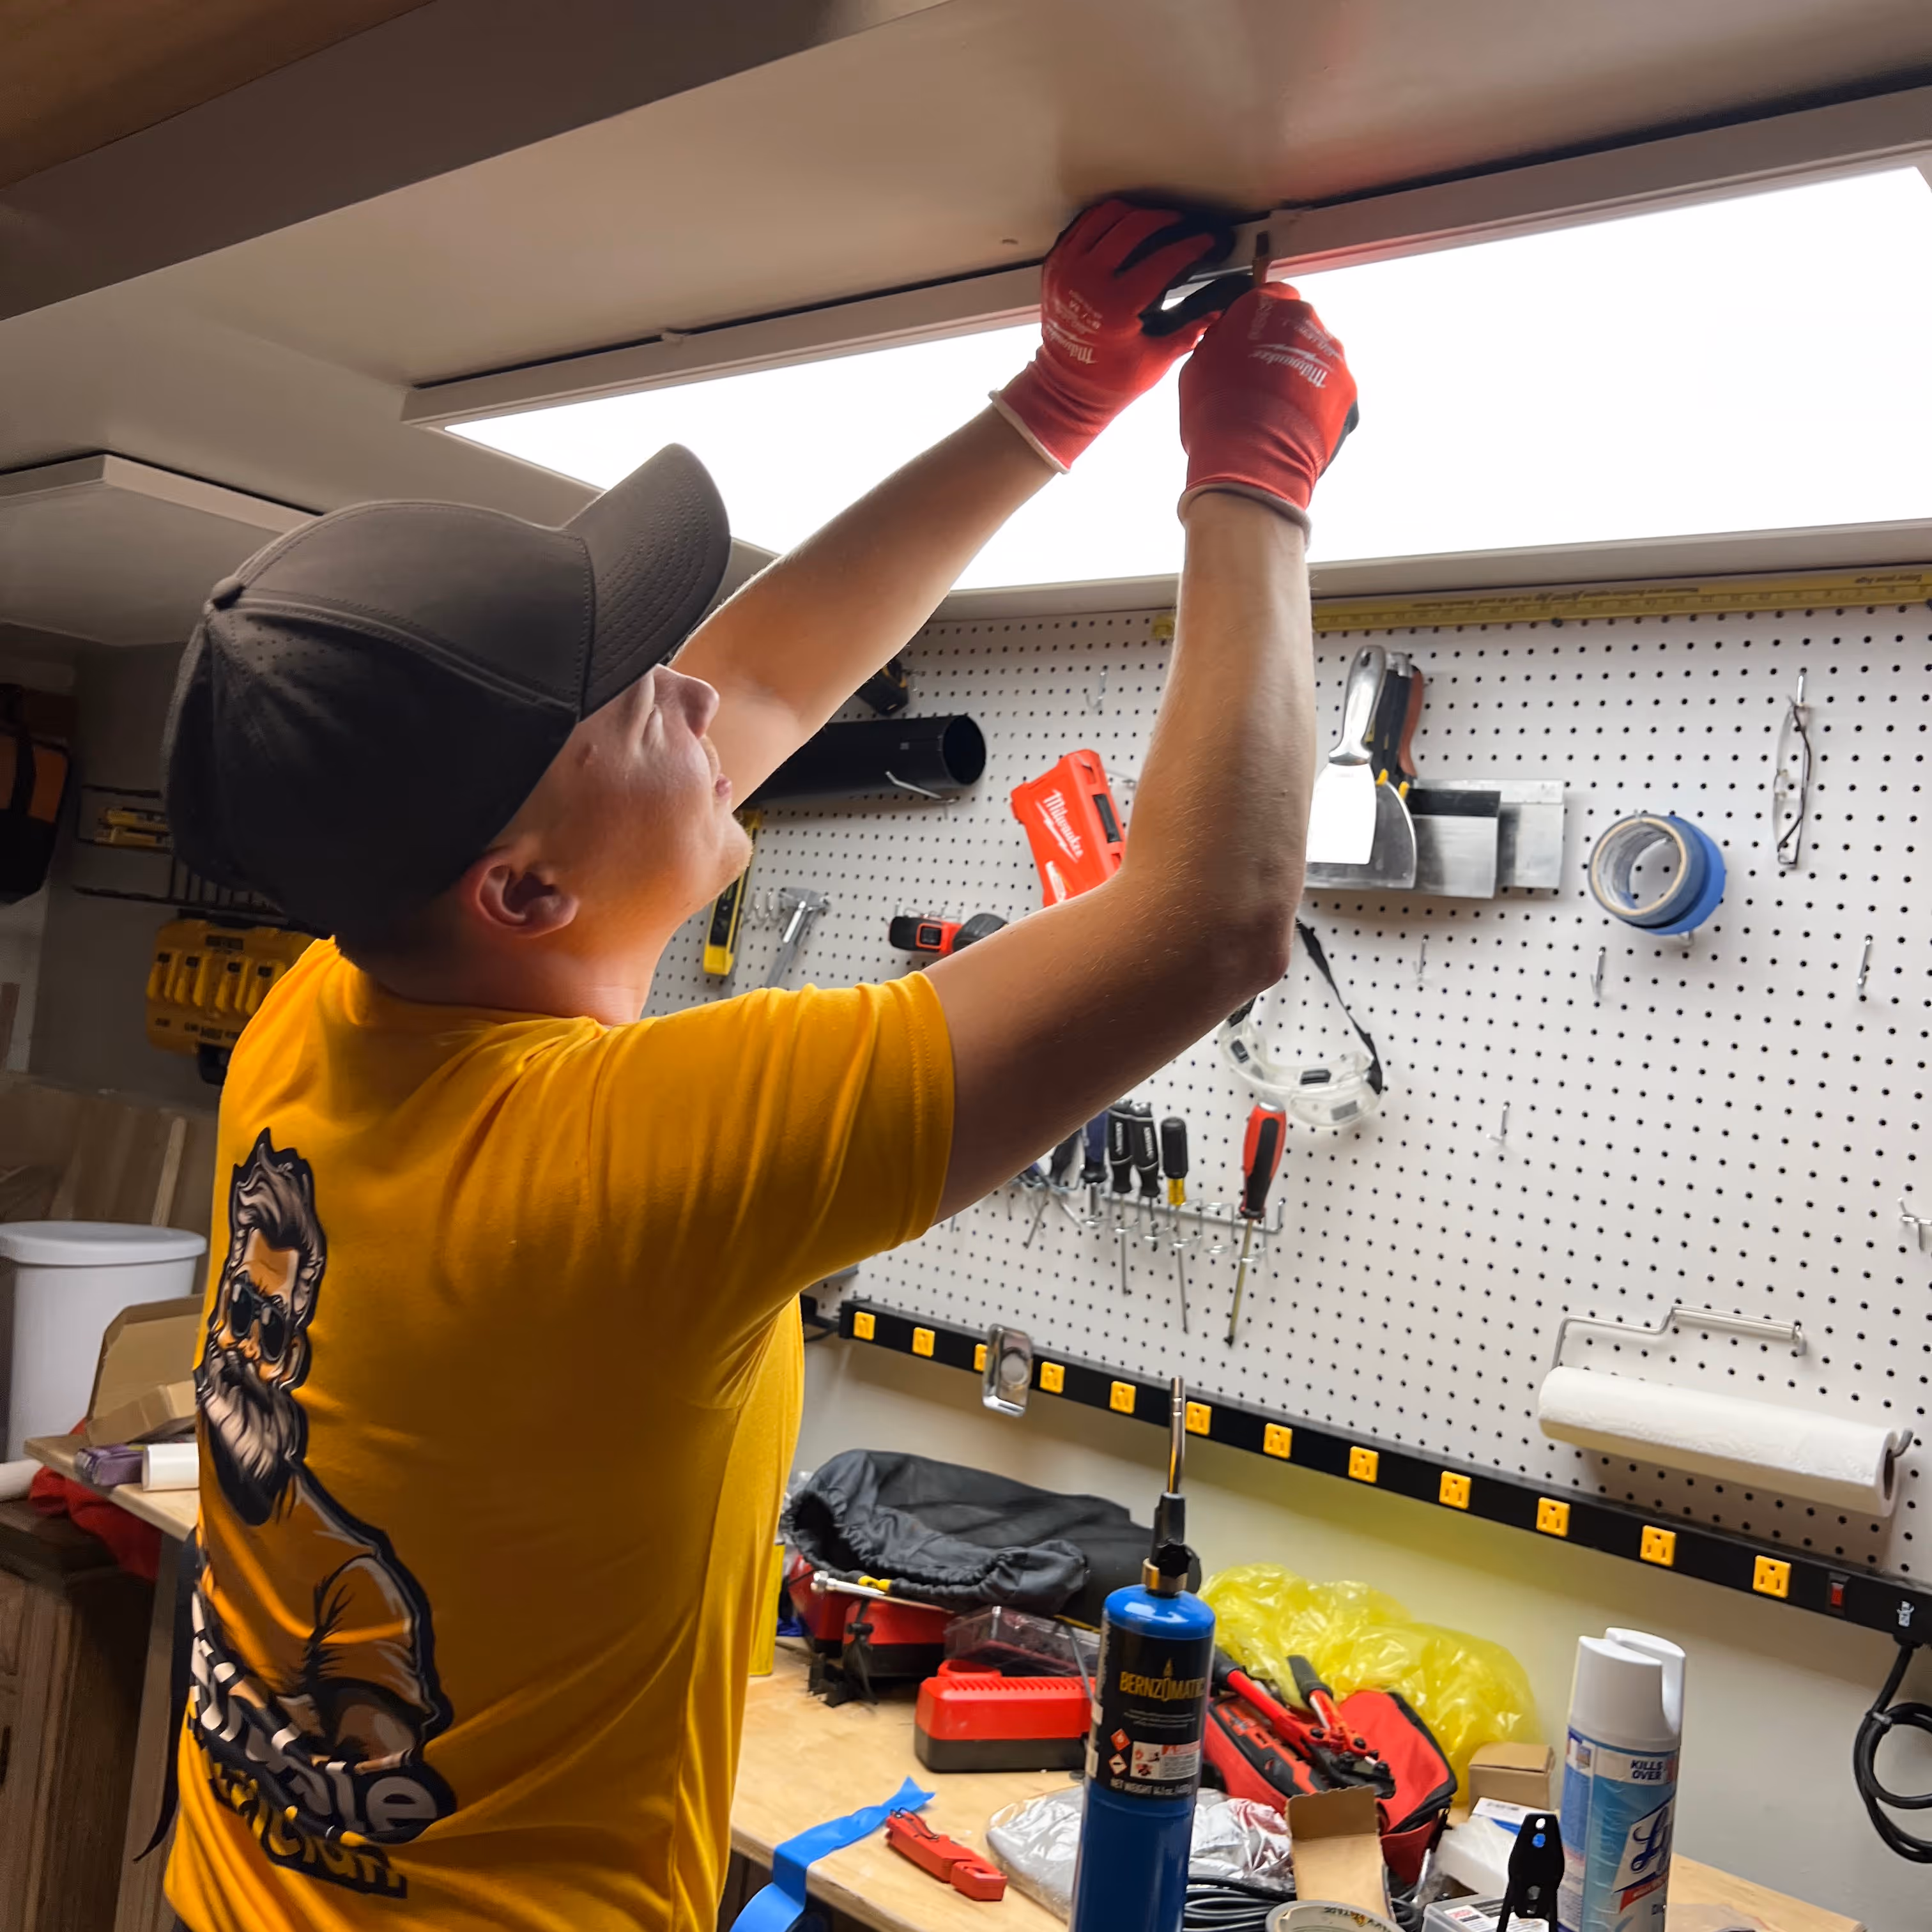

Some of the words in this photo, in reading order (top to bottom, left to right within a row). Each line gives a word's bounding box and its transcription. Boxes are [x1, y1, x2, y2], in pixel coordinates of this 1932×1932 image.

[1043, 788, 1084, 857] Milwaukee
[1630, 1760, 1663, 1770] KILLS
[1632, 1770, 1662, 1780] OVER
